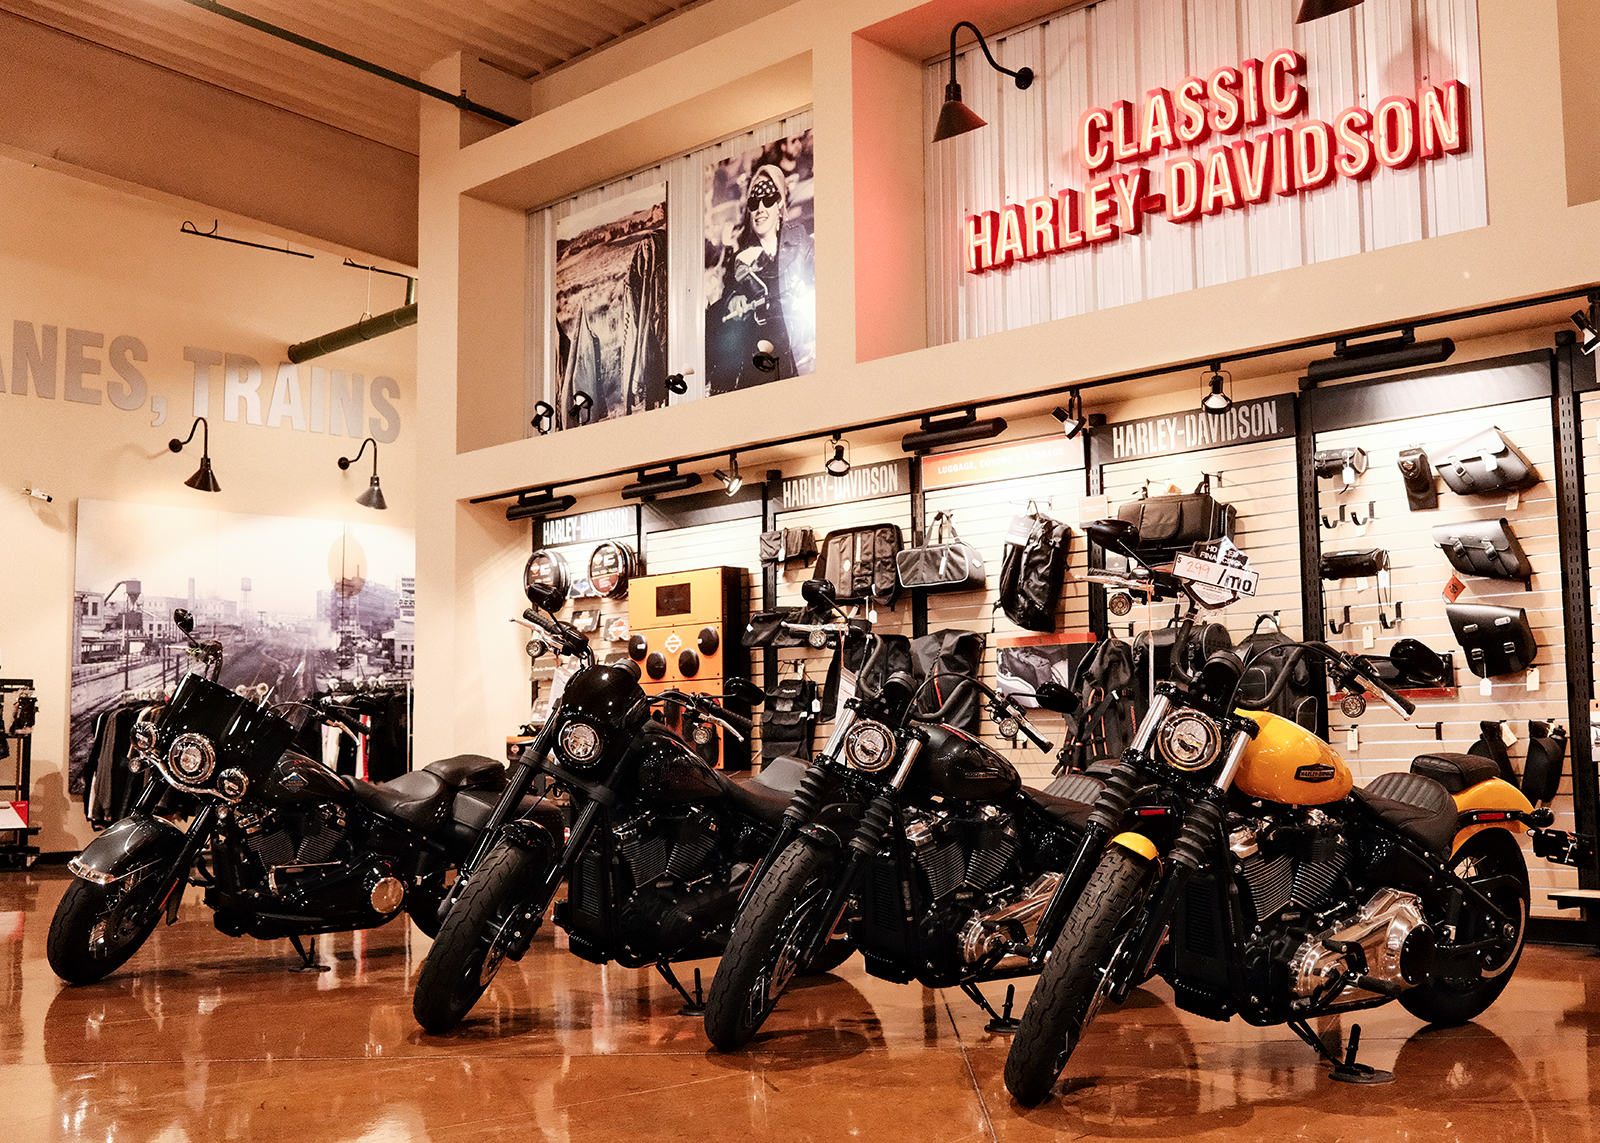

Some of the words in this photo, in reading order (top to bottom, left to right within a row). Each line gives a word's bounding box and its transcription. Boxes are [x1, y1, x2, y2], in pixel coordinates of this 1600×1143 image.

[1078, 48, 1307, 173] CLASSIC
[964, 79, 1468, 274] HARLEY-DAVIDSON
[0, 319, 169, 427] NES,
[183, 346, 401, 444] TRAINS
[1112, 400, 1278, 459] HARLEY-DAVIDSON
[937, 461, 977, 475] LUGGAGE,
[979, 453, 1013, 468] COVERS
[1025, 447, 1064, 461] STORAGE
[782, 463, 899, 509] HARLEY-DAVIDSON
[542, 507, 629, 546] HARLEY-DAVIDSON
[1205, 544, 1218, 554] HD
[1186, 560, 1211, 579] 299
